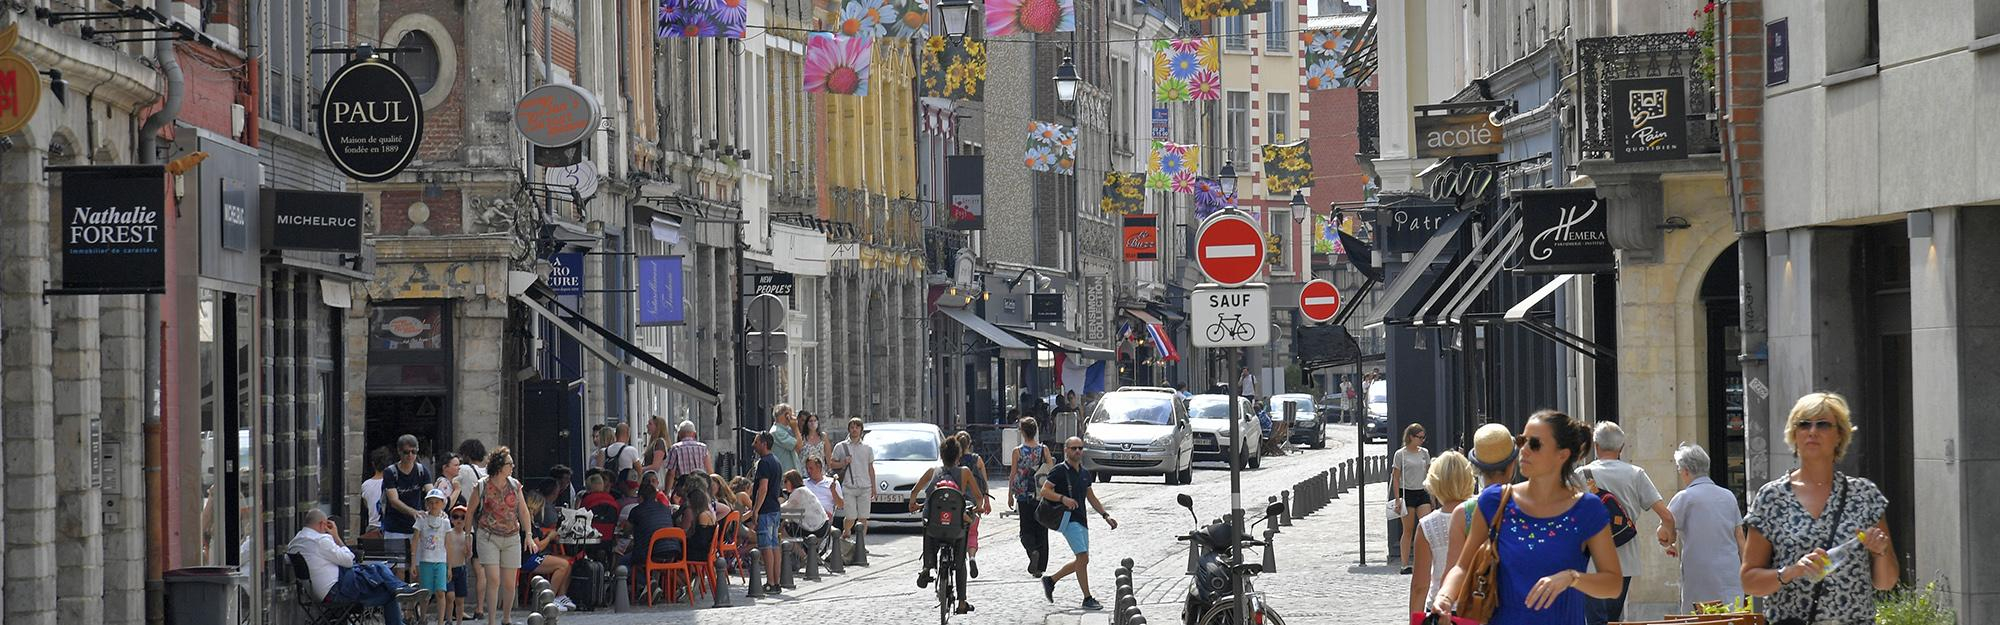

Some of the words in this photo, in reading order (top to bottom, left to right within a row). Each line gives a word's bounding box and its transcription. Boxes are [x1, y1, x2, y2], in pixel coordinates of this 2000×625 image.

[332, 100, 409, 124] PAUL
[340, 136, 367, 144] Maison
[378, 135, 403, 145] qualité
[1426, 122, 1492, 149] acoté
[1631, 126, 1668, 146] Pain
[344, 146, 369, 154] fondée
[381, 145, 400, 153] 1889
[1624, 144, 1678, 154] QUOTIDIEN
[71, 206, 157, 225] Nathalie
[276, 214, 357, 228] MICHELRUC
[1394, 210, 1450, 232] Patr
[70, 225, 158, 244] FOREST
[756, 284, 792, 294] PEOPLE'S
[759, 276, 774, 284] NEW
[1095, 276, 1104, 340] COLLECTION
[1209, 294, 1251, 308] SAUF
[1088, 286, 1096, 340] BENSIMON
